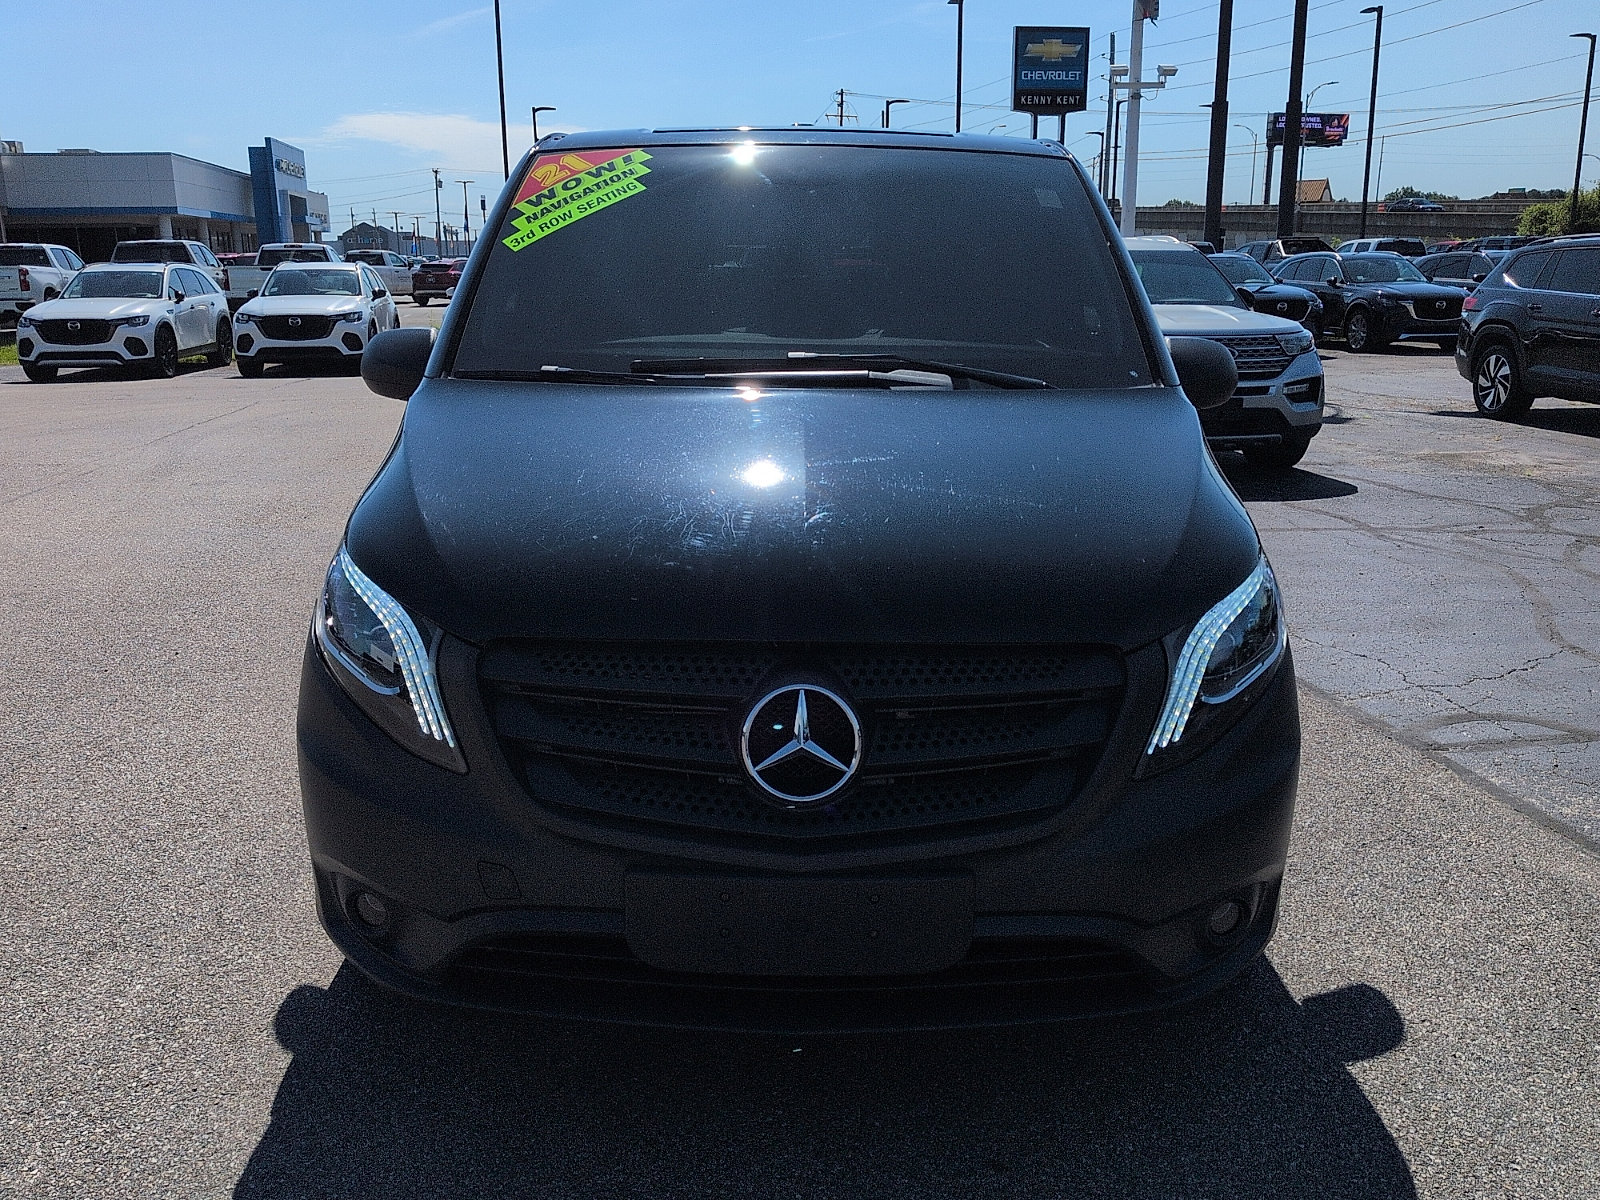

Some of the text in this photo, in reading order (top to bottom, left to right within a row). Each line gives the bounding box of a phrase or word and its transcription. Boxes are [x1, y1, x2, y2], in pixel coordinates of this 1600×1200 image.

[1021, 71, 1081, 80] CHEVROLET
[1020, 95, 1080, 105] KENNY KENT
[524, 155, 635, 208] WOW!
[531, 153, 594, 187] 21
[509, 182, 638, 248] 3rd ROW SEATING
[524, 167, 637, 224] NAVIGATION
